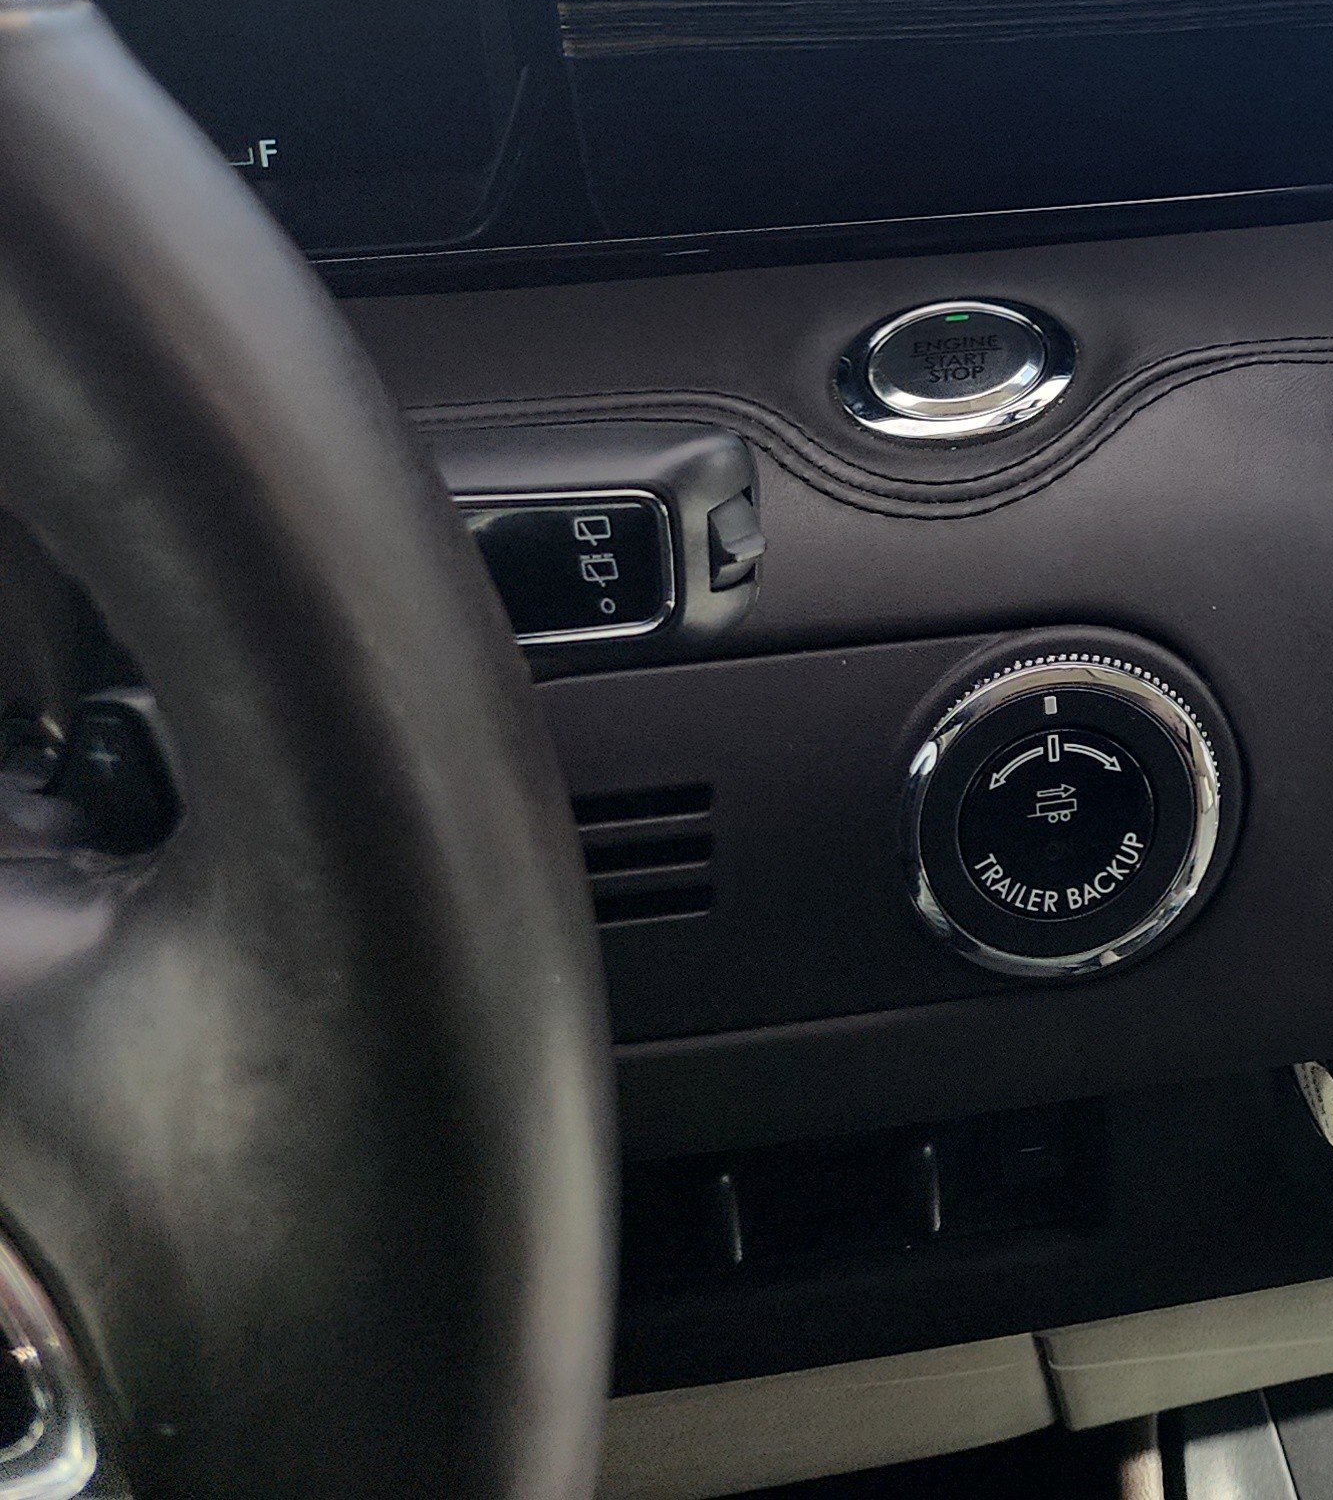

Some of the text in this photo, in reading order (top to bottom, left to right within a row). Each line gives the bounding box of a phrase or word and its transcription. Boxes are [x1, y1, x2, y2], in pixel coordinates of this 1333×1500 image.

[258, 139, 278, 169] F
[913, 334, 1001, 354] ENGINE
[924, 352, 989, 370] START
[928, 366, 986, 384] STOP
[974, 832, 1145, 913] TRAILER BACKUP
